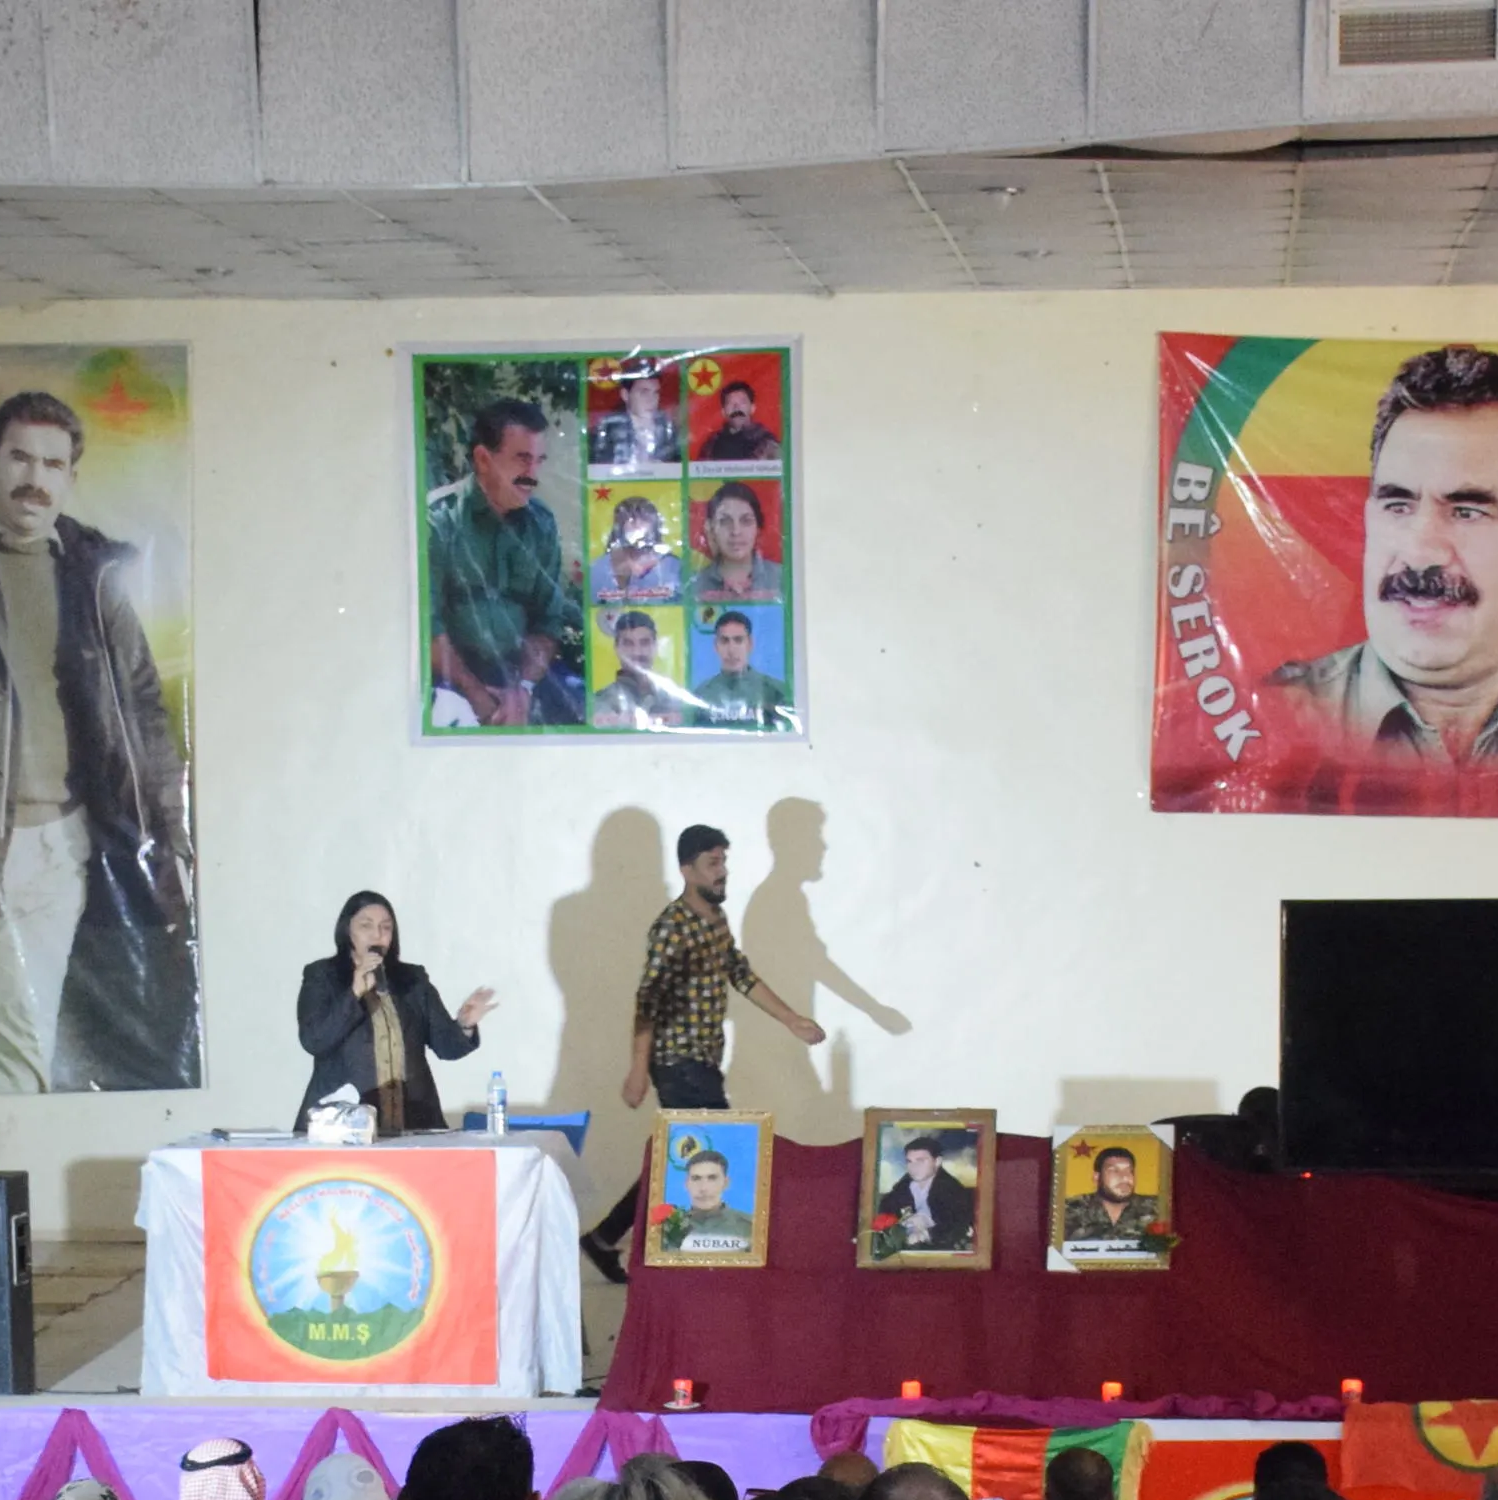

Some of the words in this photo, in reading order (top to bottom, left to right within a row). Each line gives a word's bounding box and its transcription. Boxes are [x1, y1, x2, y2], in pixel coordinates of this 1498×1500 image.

[1166, 460, 1222, 543] BÊ
[1168, 564, 1262, 763] SEROK
[308, 1322, 371, 1346] M.M.Ş
